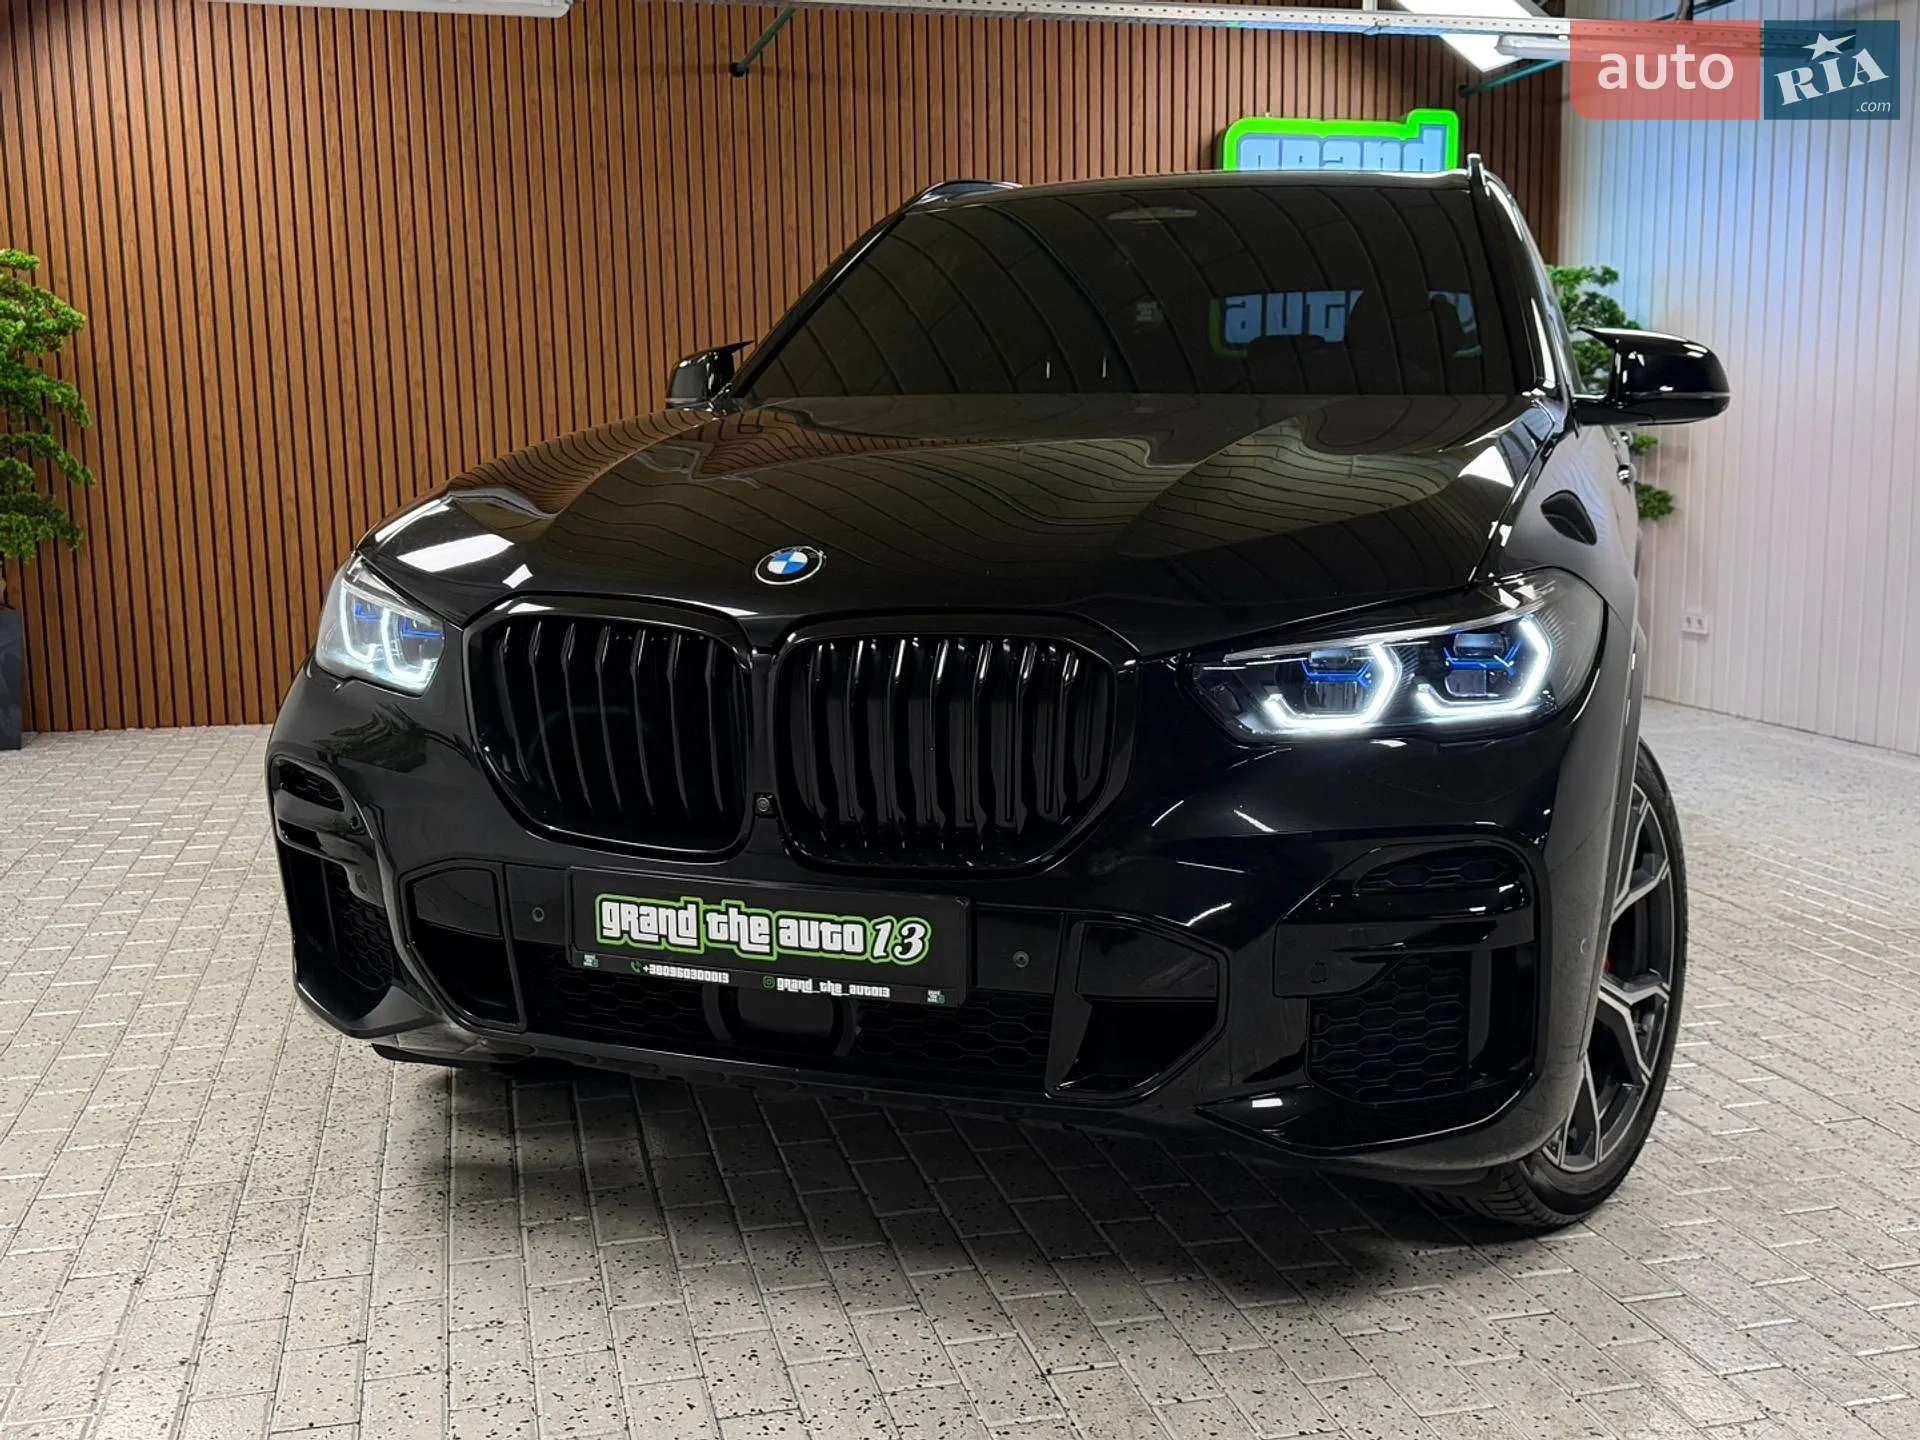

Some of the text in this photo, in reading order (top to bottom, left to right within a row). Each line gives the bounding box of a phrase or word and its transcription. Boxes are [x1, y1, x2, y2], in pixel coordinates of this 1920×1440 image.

[1224, 289, 1364, 343] aut
[601, 901, 698, 946] grand
[706, 907, 770, 953] the
